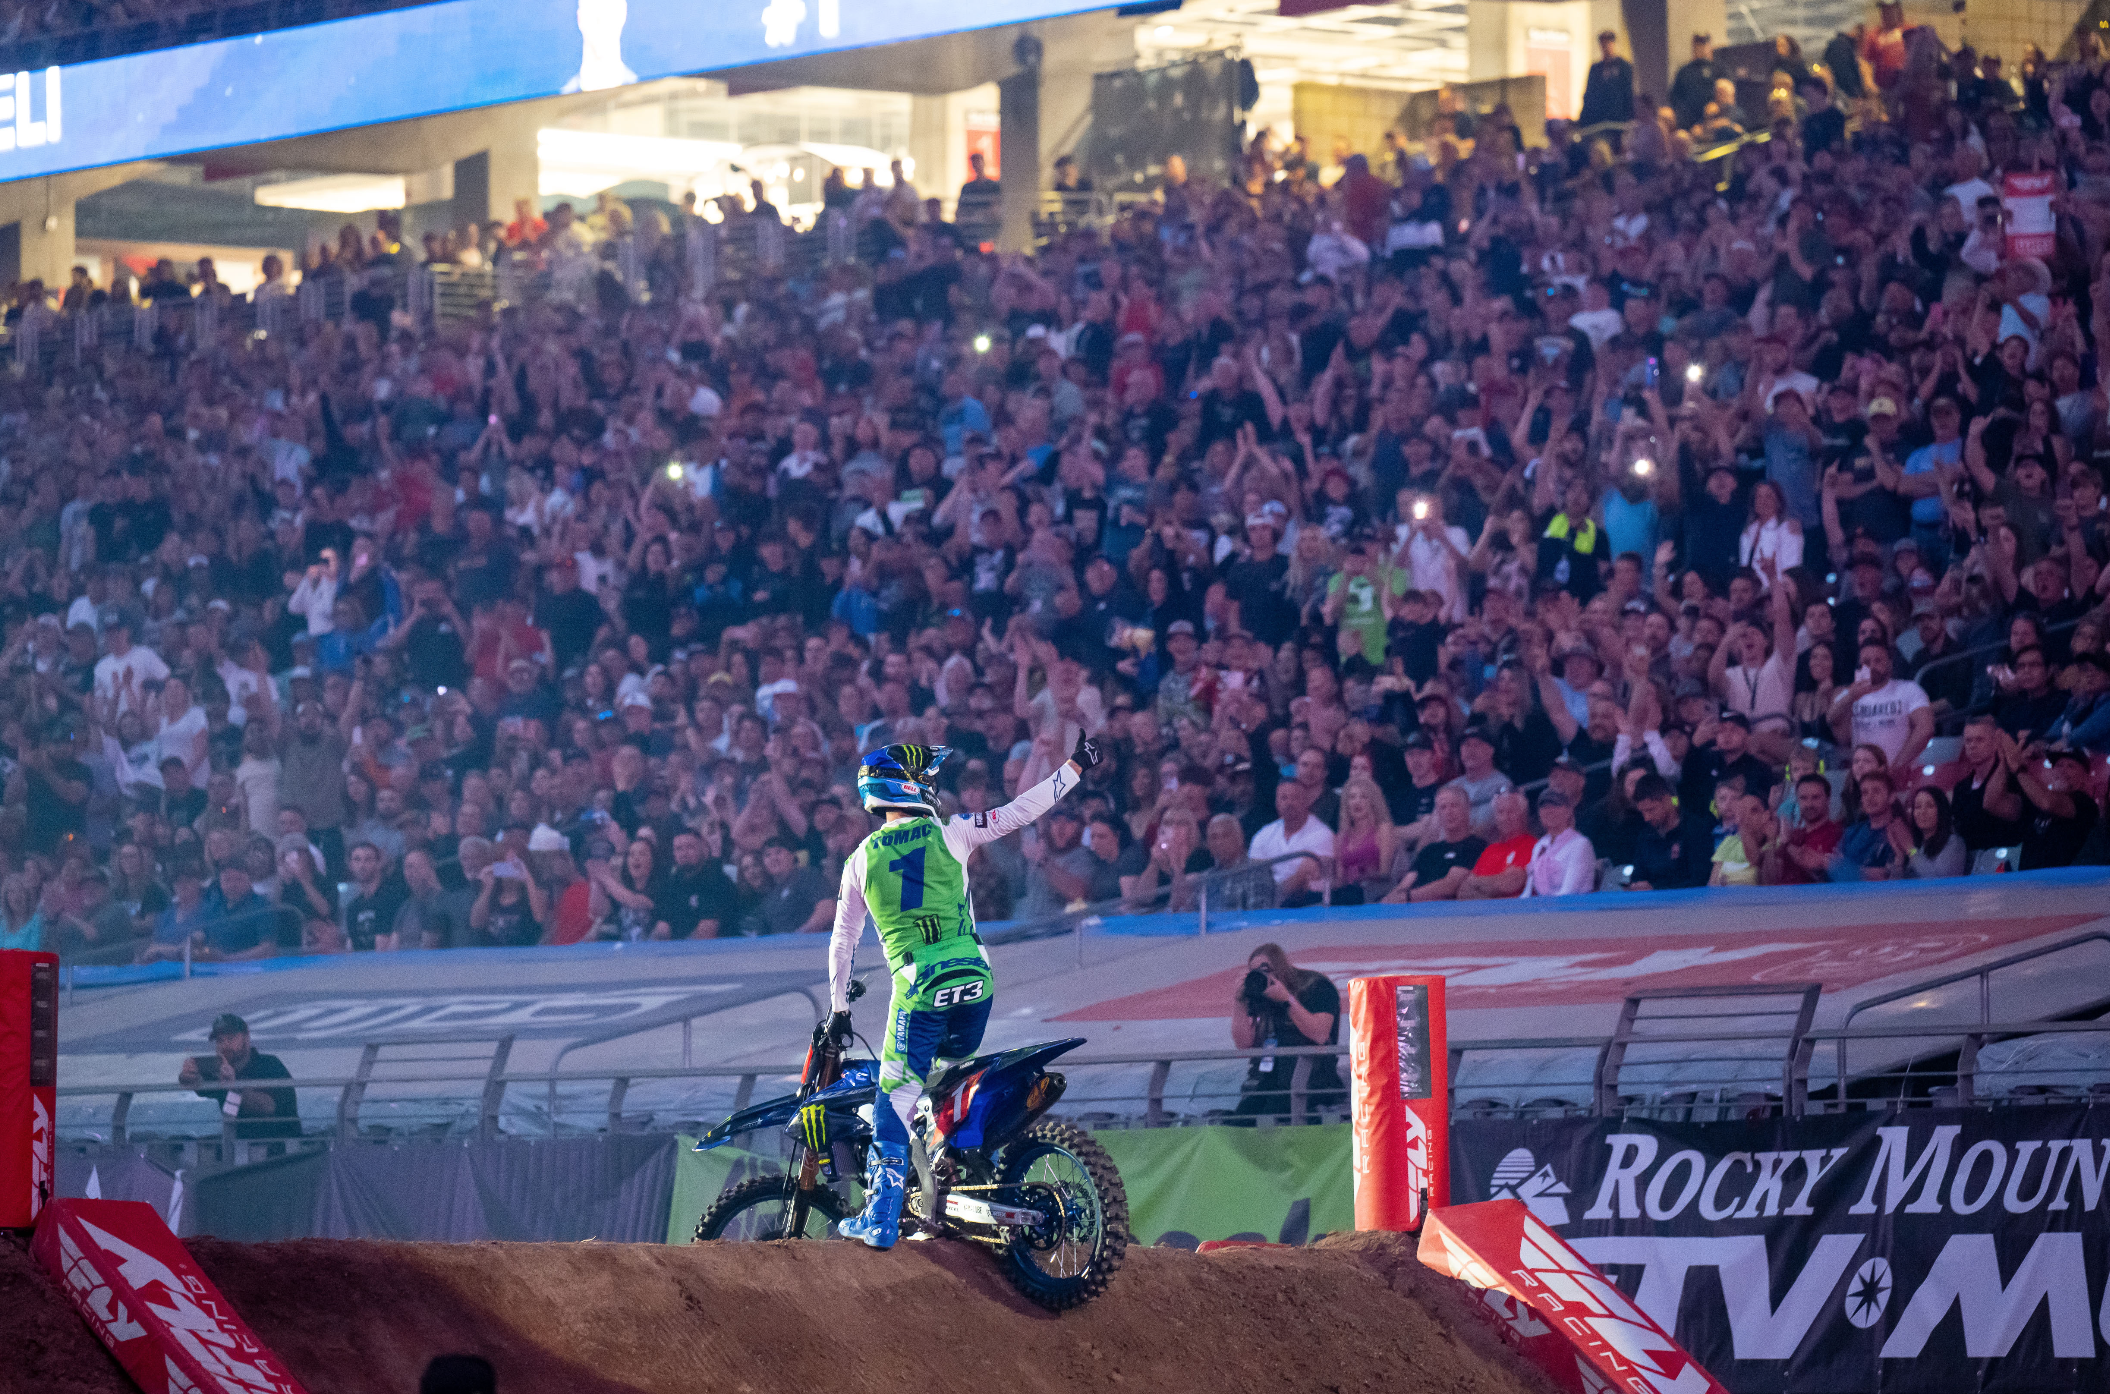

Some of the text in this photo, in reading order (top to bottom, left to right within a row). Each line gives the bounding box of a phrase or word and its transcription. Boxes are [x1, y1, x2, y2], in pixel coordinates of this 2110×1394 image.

[903, 784, 917, 793] BELL
[873, 823, 933, 850] TOMAC
[888, 845, 926, 913] 1
[933, 979, 985, 1008] ET3
[951, 1080, 967, 1123] 1
[1356, 1041, 1371, 1174] RACING
[1582, 1133, 1849, 1222] ROCKY
[57, 1222, 148, 1342] FLY
